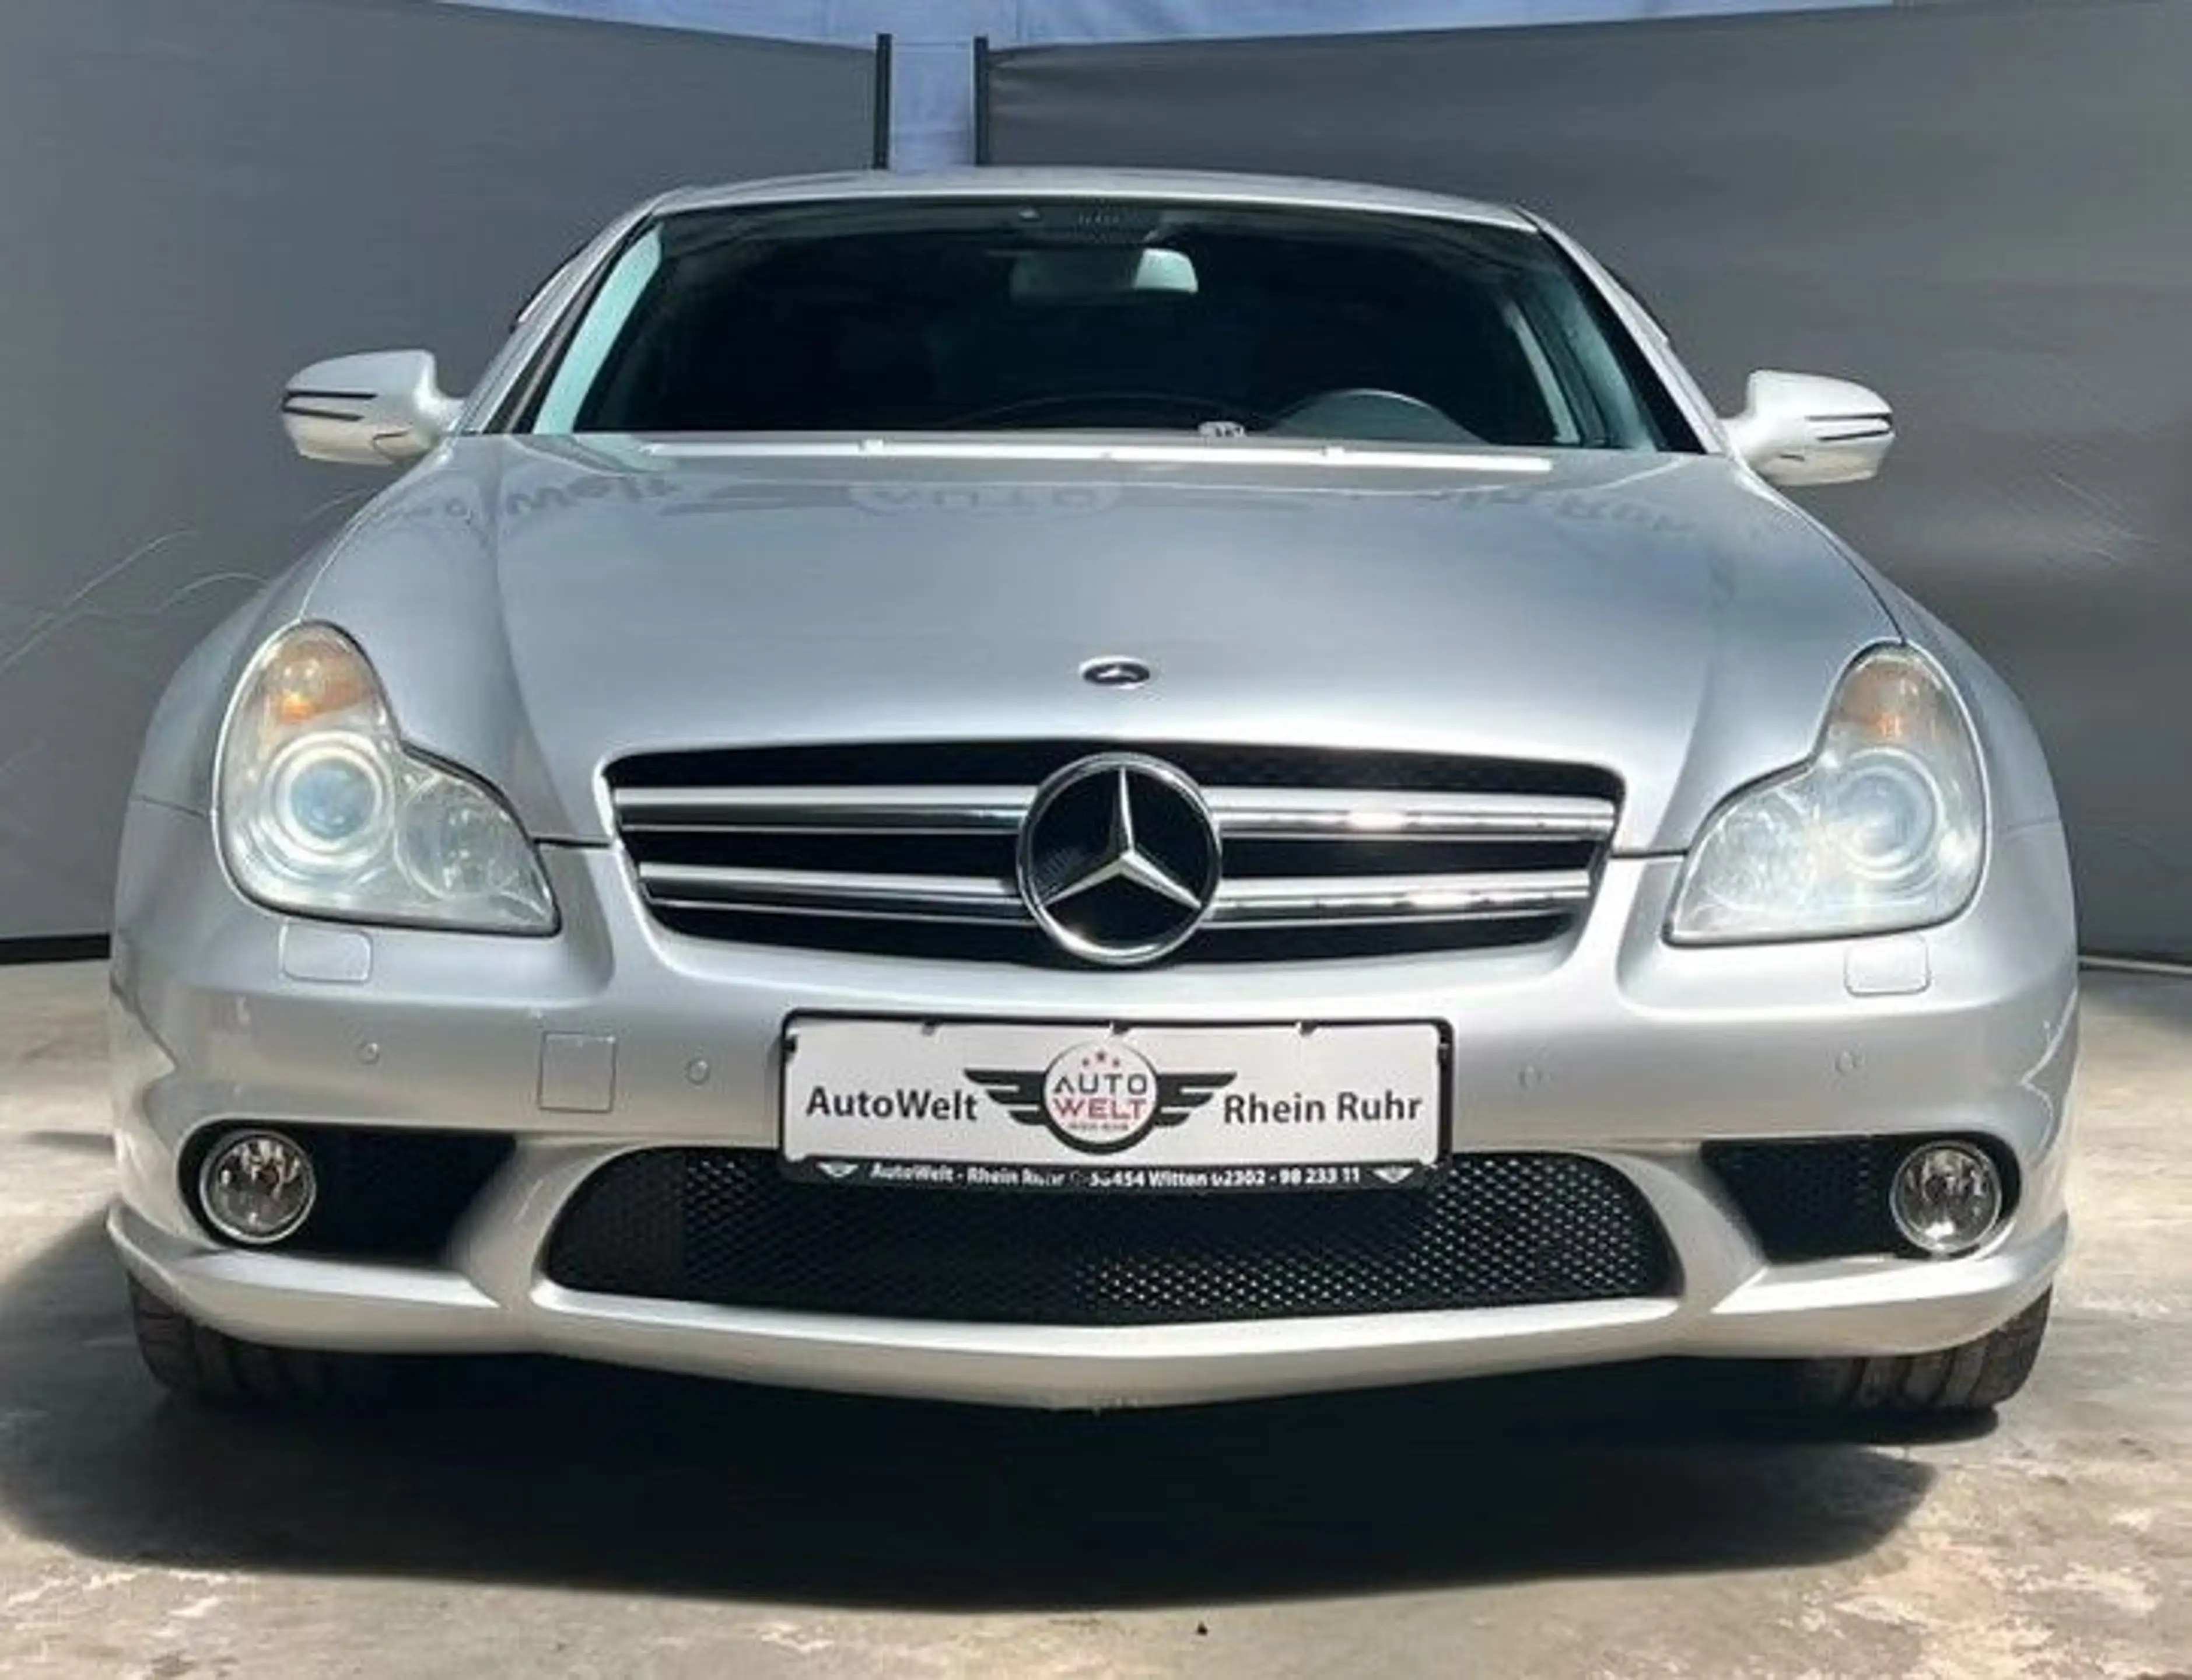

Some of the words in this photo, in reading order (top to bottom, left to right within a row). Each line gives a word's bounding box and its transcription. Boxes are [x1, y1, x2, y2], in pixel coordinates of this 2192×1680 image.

[1053, 1073, 1147, 1095] AUTO
[806, 1085, 978, 1122] AutoWelt
[1053, 1097, 1147, 1119] WELT
[1224, 1091, 1326, 1124] Rhein
[1337, 1088, 1422, 1121] Ruhr
[967, 1167, 1018, 1185] Rhein
